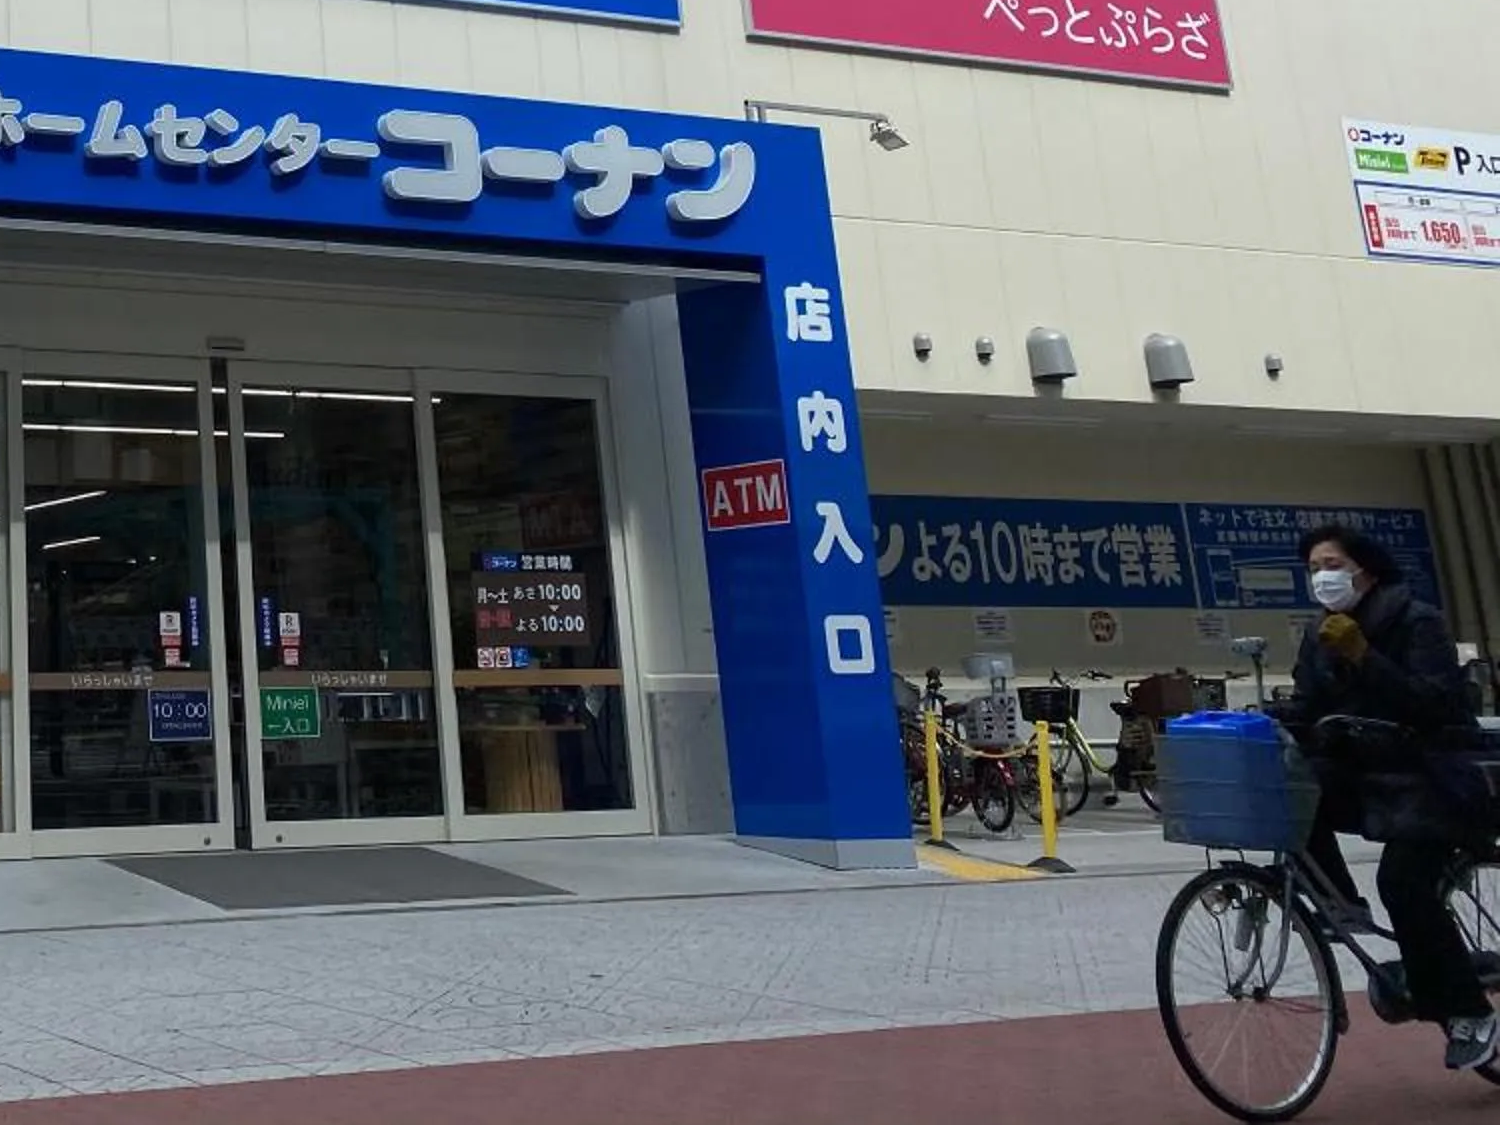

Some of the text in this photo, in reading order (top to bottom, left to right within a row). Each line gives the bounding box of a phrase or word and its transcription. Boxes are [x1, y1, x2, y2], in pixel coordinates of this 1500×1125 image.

[1360, 129, 1404, 145] コーナン
[1454, 147, 1470, 174] P
[784, 282, 875, 674] 店内入口
[712, 475, 783, 518] ATM
[538, 583, 582, 601] 10:00
[515, 618, 539, 632] よる
[540, 615, 585, 632] 10:00
